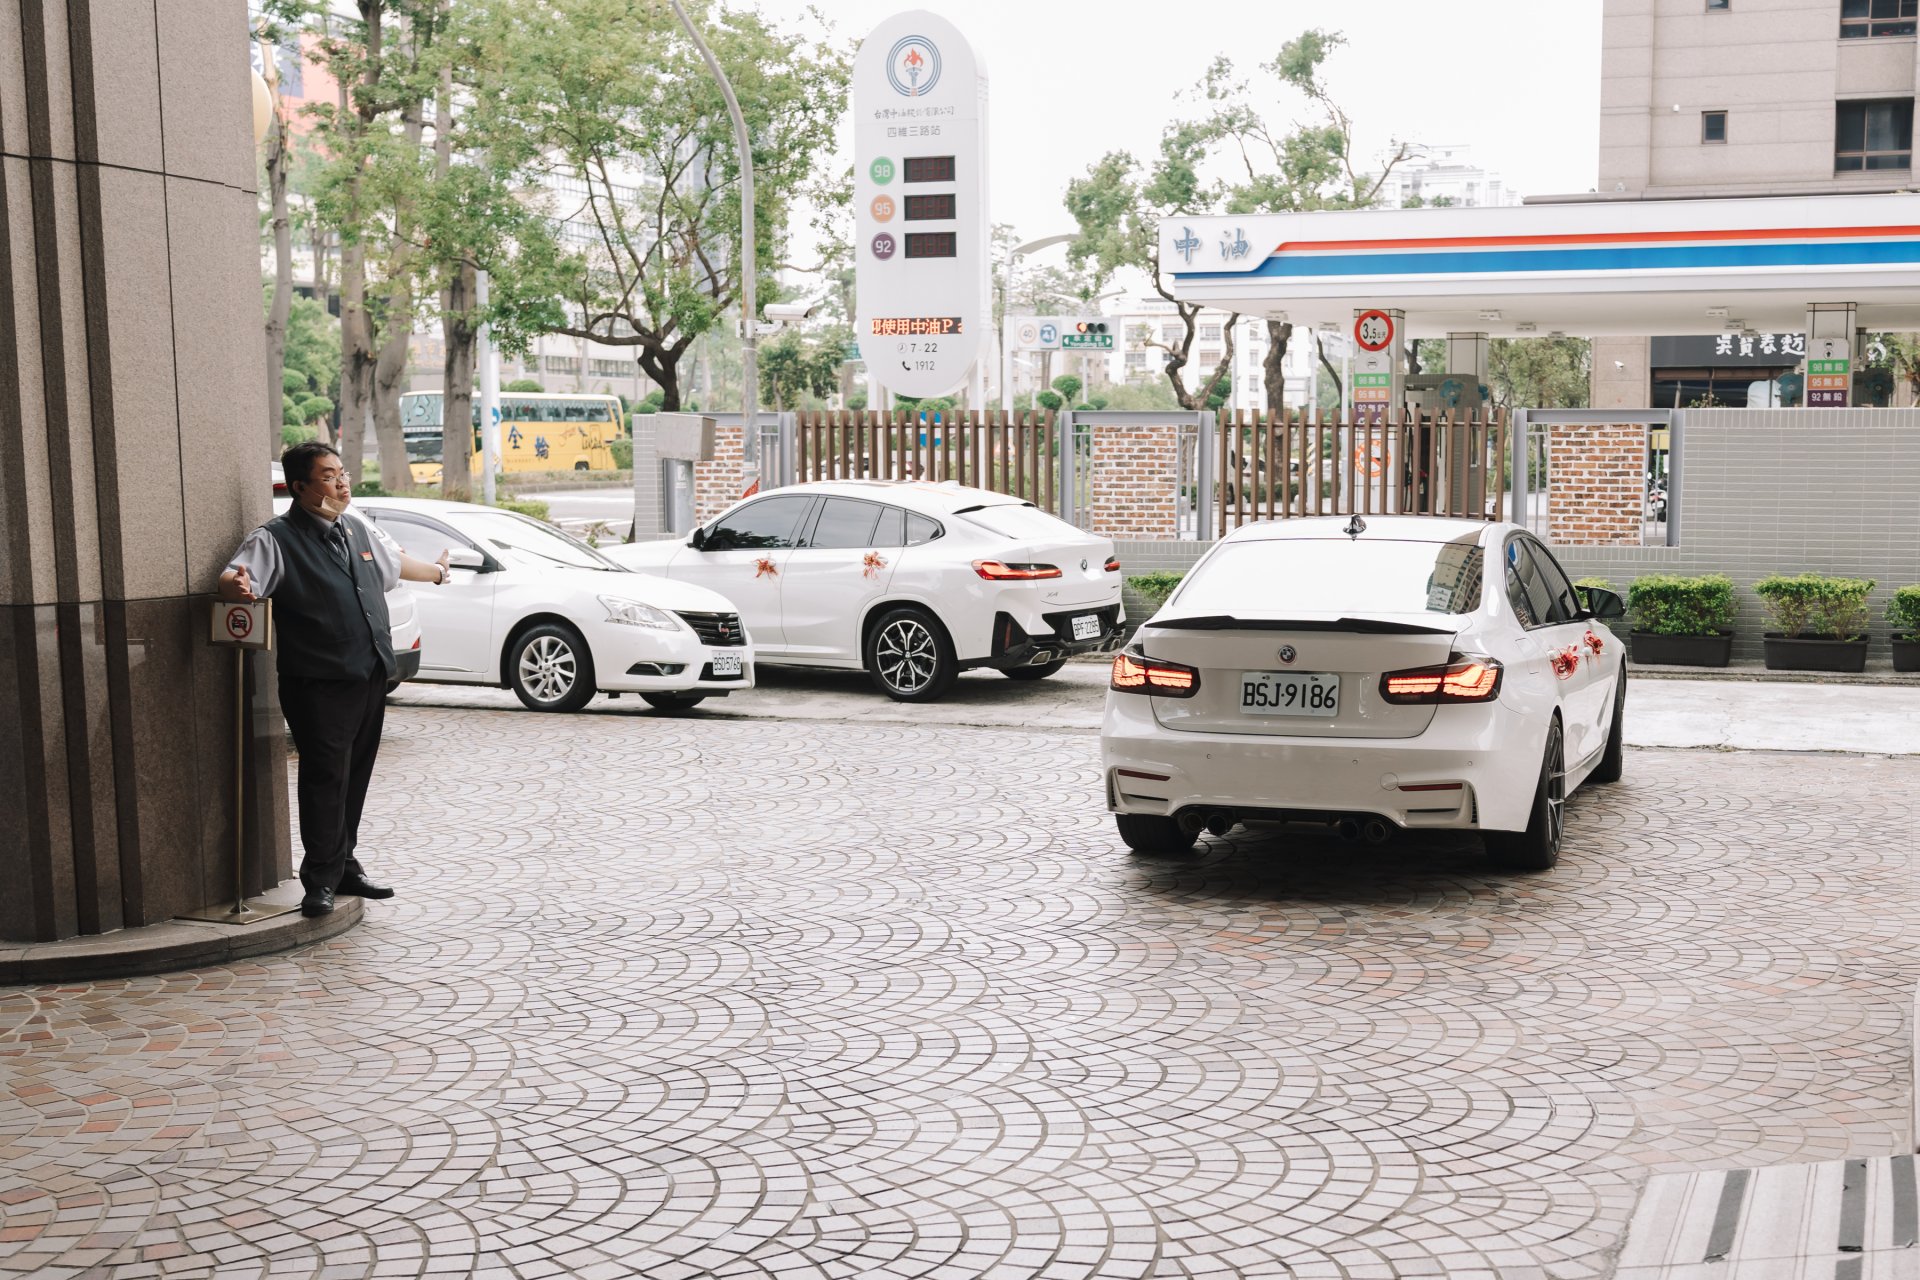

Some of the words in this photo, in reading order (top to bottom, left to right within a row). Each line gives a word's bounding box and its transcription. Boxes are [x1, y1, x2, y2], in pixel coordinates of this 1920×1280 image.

[887, 125, 941, 138] 四維三路站
[874, 164, 891, 178] 98
[874, 202, 891, 215] 95
[875, 240, 892, 253] 92
[1173, 226, 1250, 263] 中油
[915, 360, 935, 370] 1912
